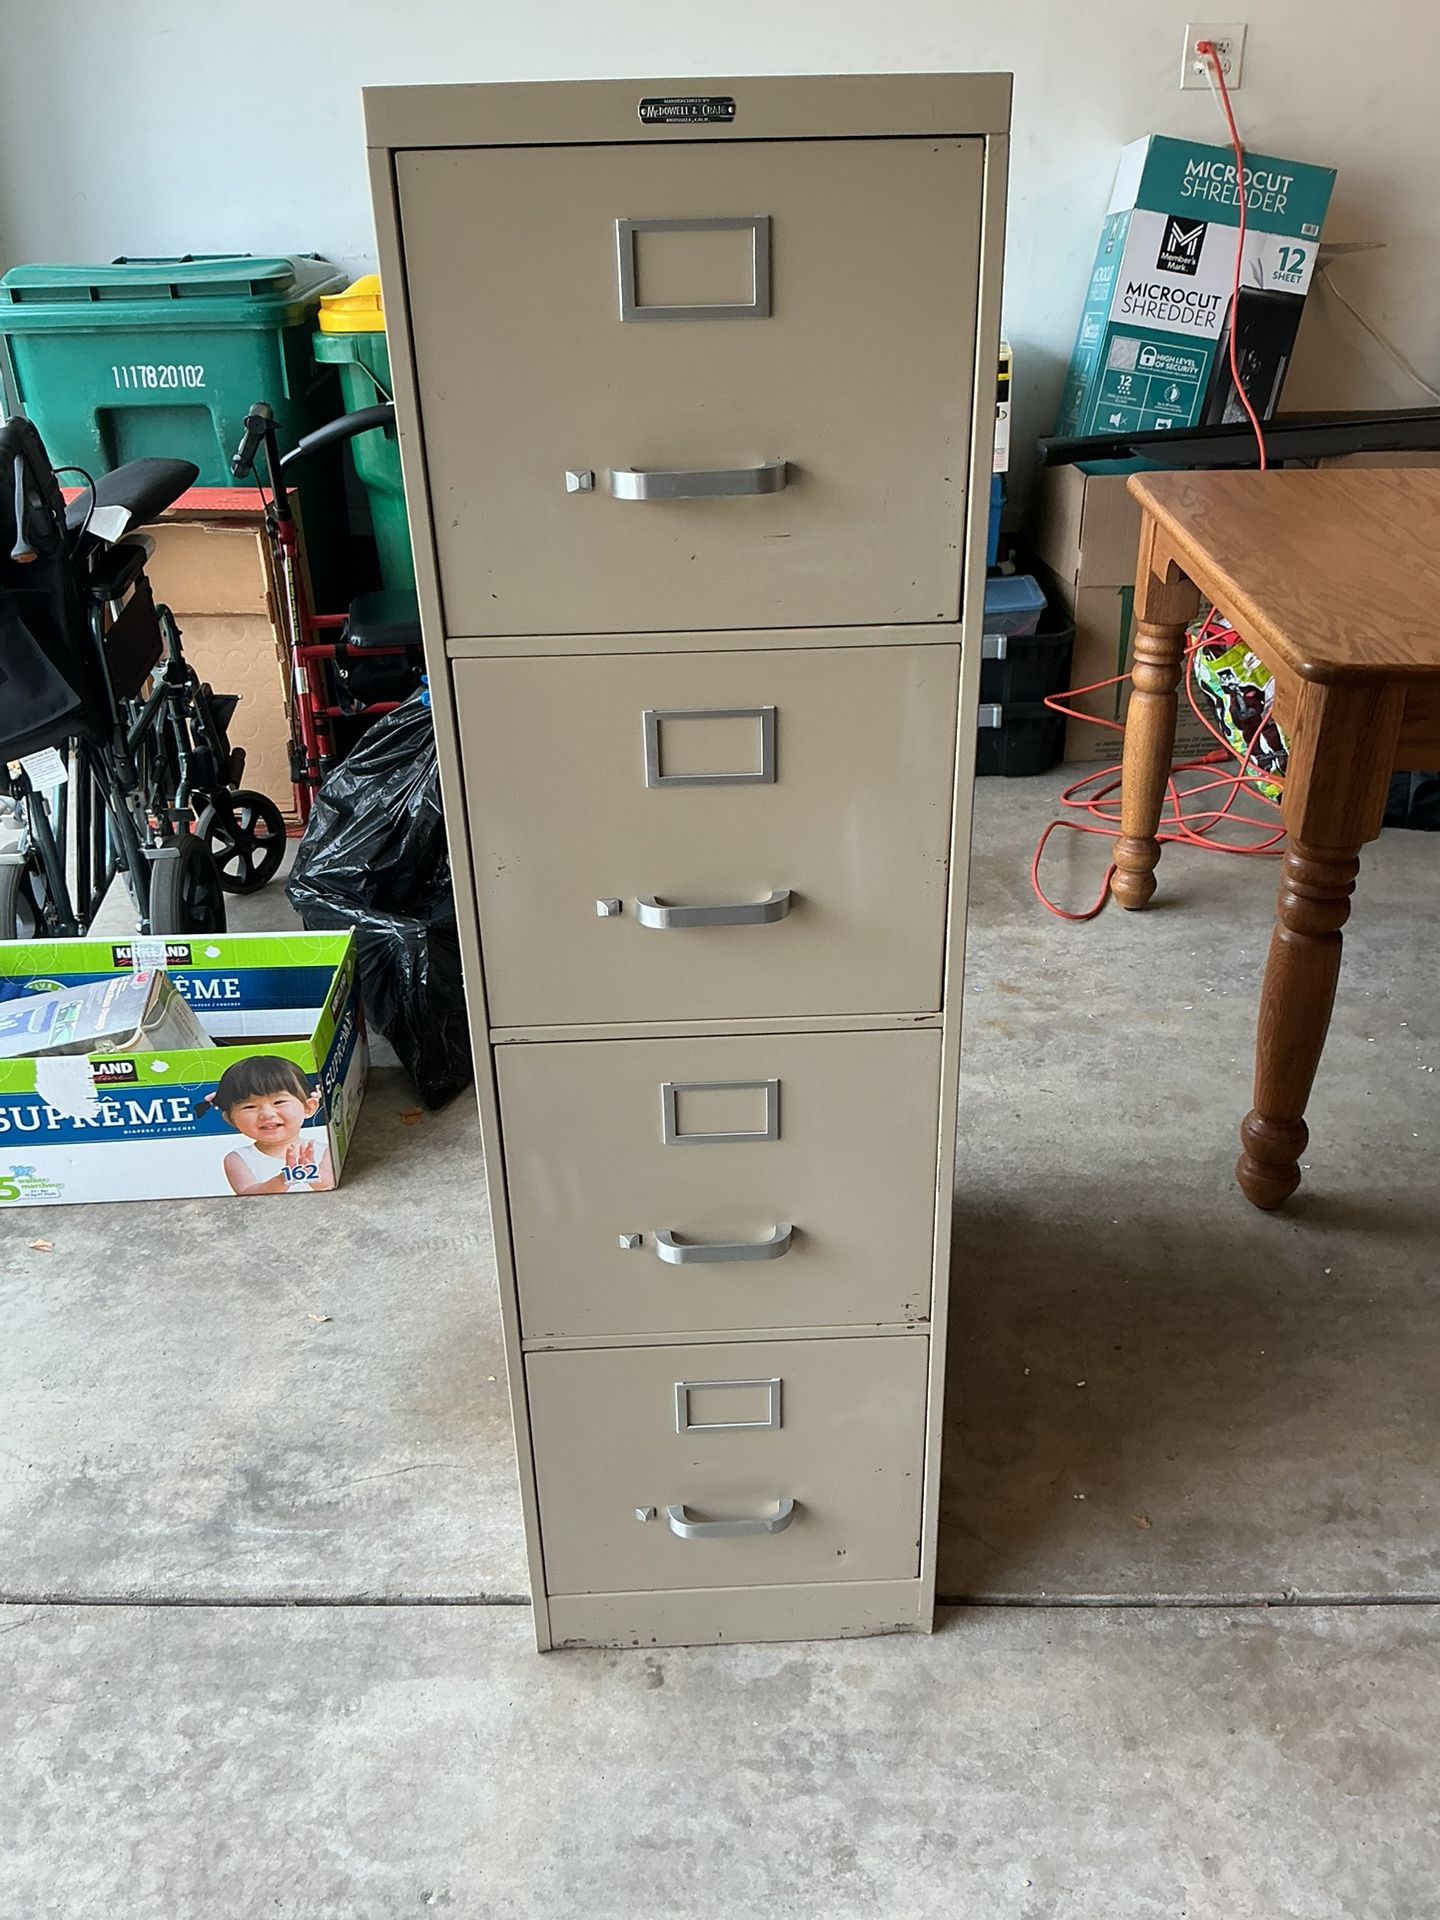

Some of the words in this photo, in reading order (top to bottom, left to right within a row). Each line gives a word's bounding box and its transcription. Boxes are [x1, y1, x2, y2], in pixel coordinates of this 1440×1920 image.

[692, 105, 698, 115] &
[1185, 158, 1294, 194] MICROCUT
[1180, 176, 1288, 214] SHREDDER
[1161, 252, 1197, 265] Member's
[1279, 247, 1306, 274] 12
[1272, 271, 1302, 283] SHEET
[1126, 281, 1222, 310] MICROCUT
[1121, 296, 1216, 329] SHREDDER
[1154, 361, 1165, 369] OF
[1165, 362, 1199, 375] SECURITY
[1156, 353, 1175, 363] HIGH
[1176, 356, 1195, 367] LEVEL
[112, 365, 206, 388] 1117820102
[1120, 375, 1132, 387] 12
[281, 1164, 319, 1180] 162
[0, 1176, 21, 1200] 5
